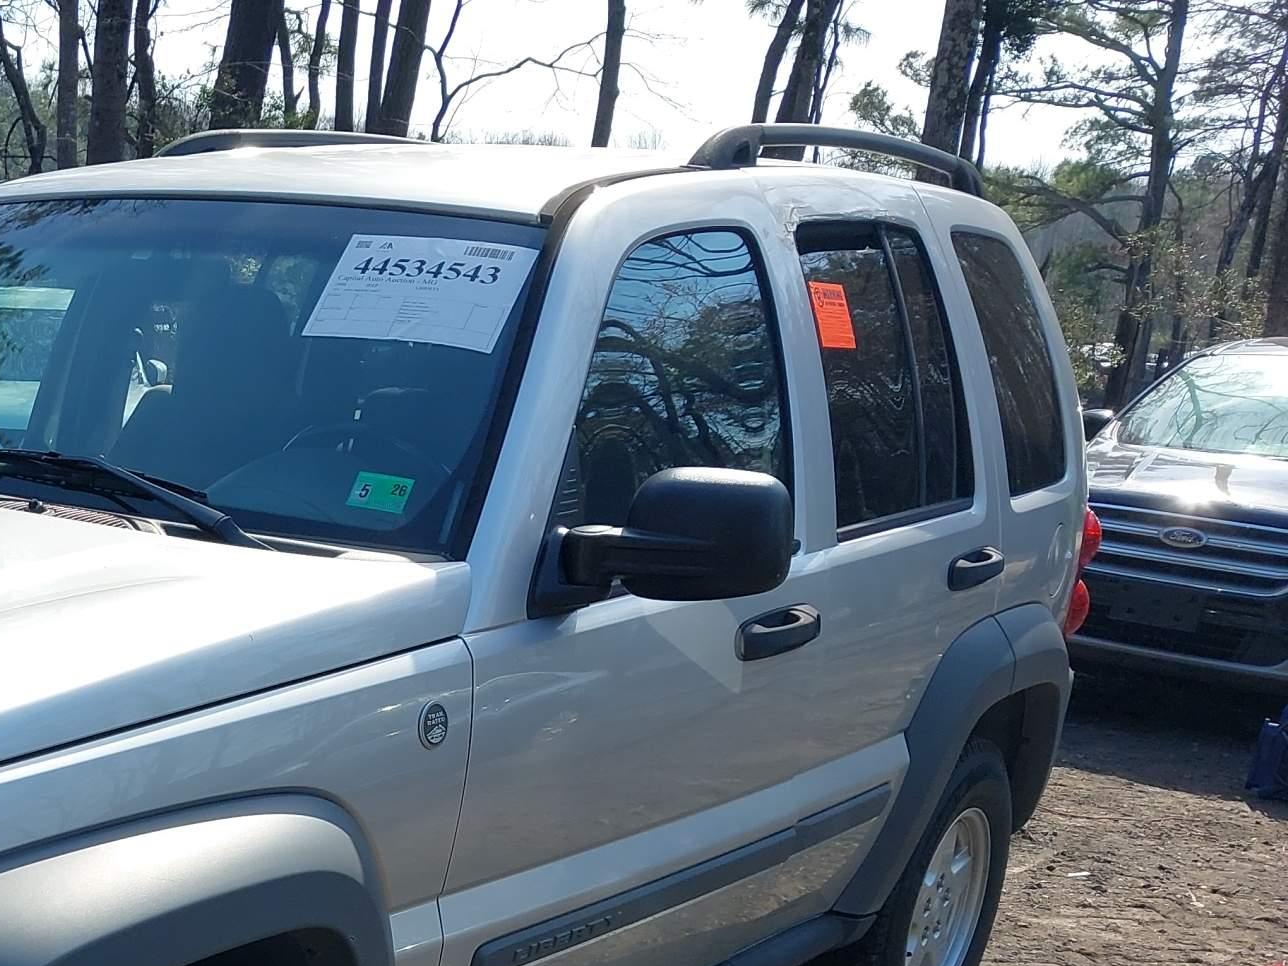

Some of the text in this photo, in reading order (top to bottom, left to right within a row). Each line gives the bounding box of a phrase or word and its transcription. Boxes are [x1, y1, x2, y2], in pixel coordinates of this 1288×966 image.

[353, 257, 500, 285] 44534543
[359, 484, 409, 498] 5 26
